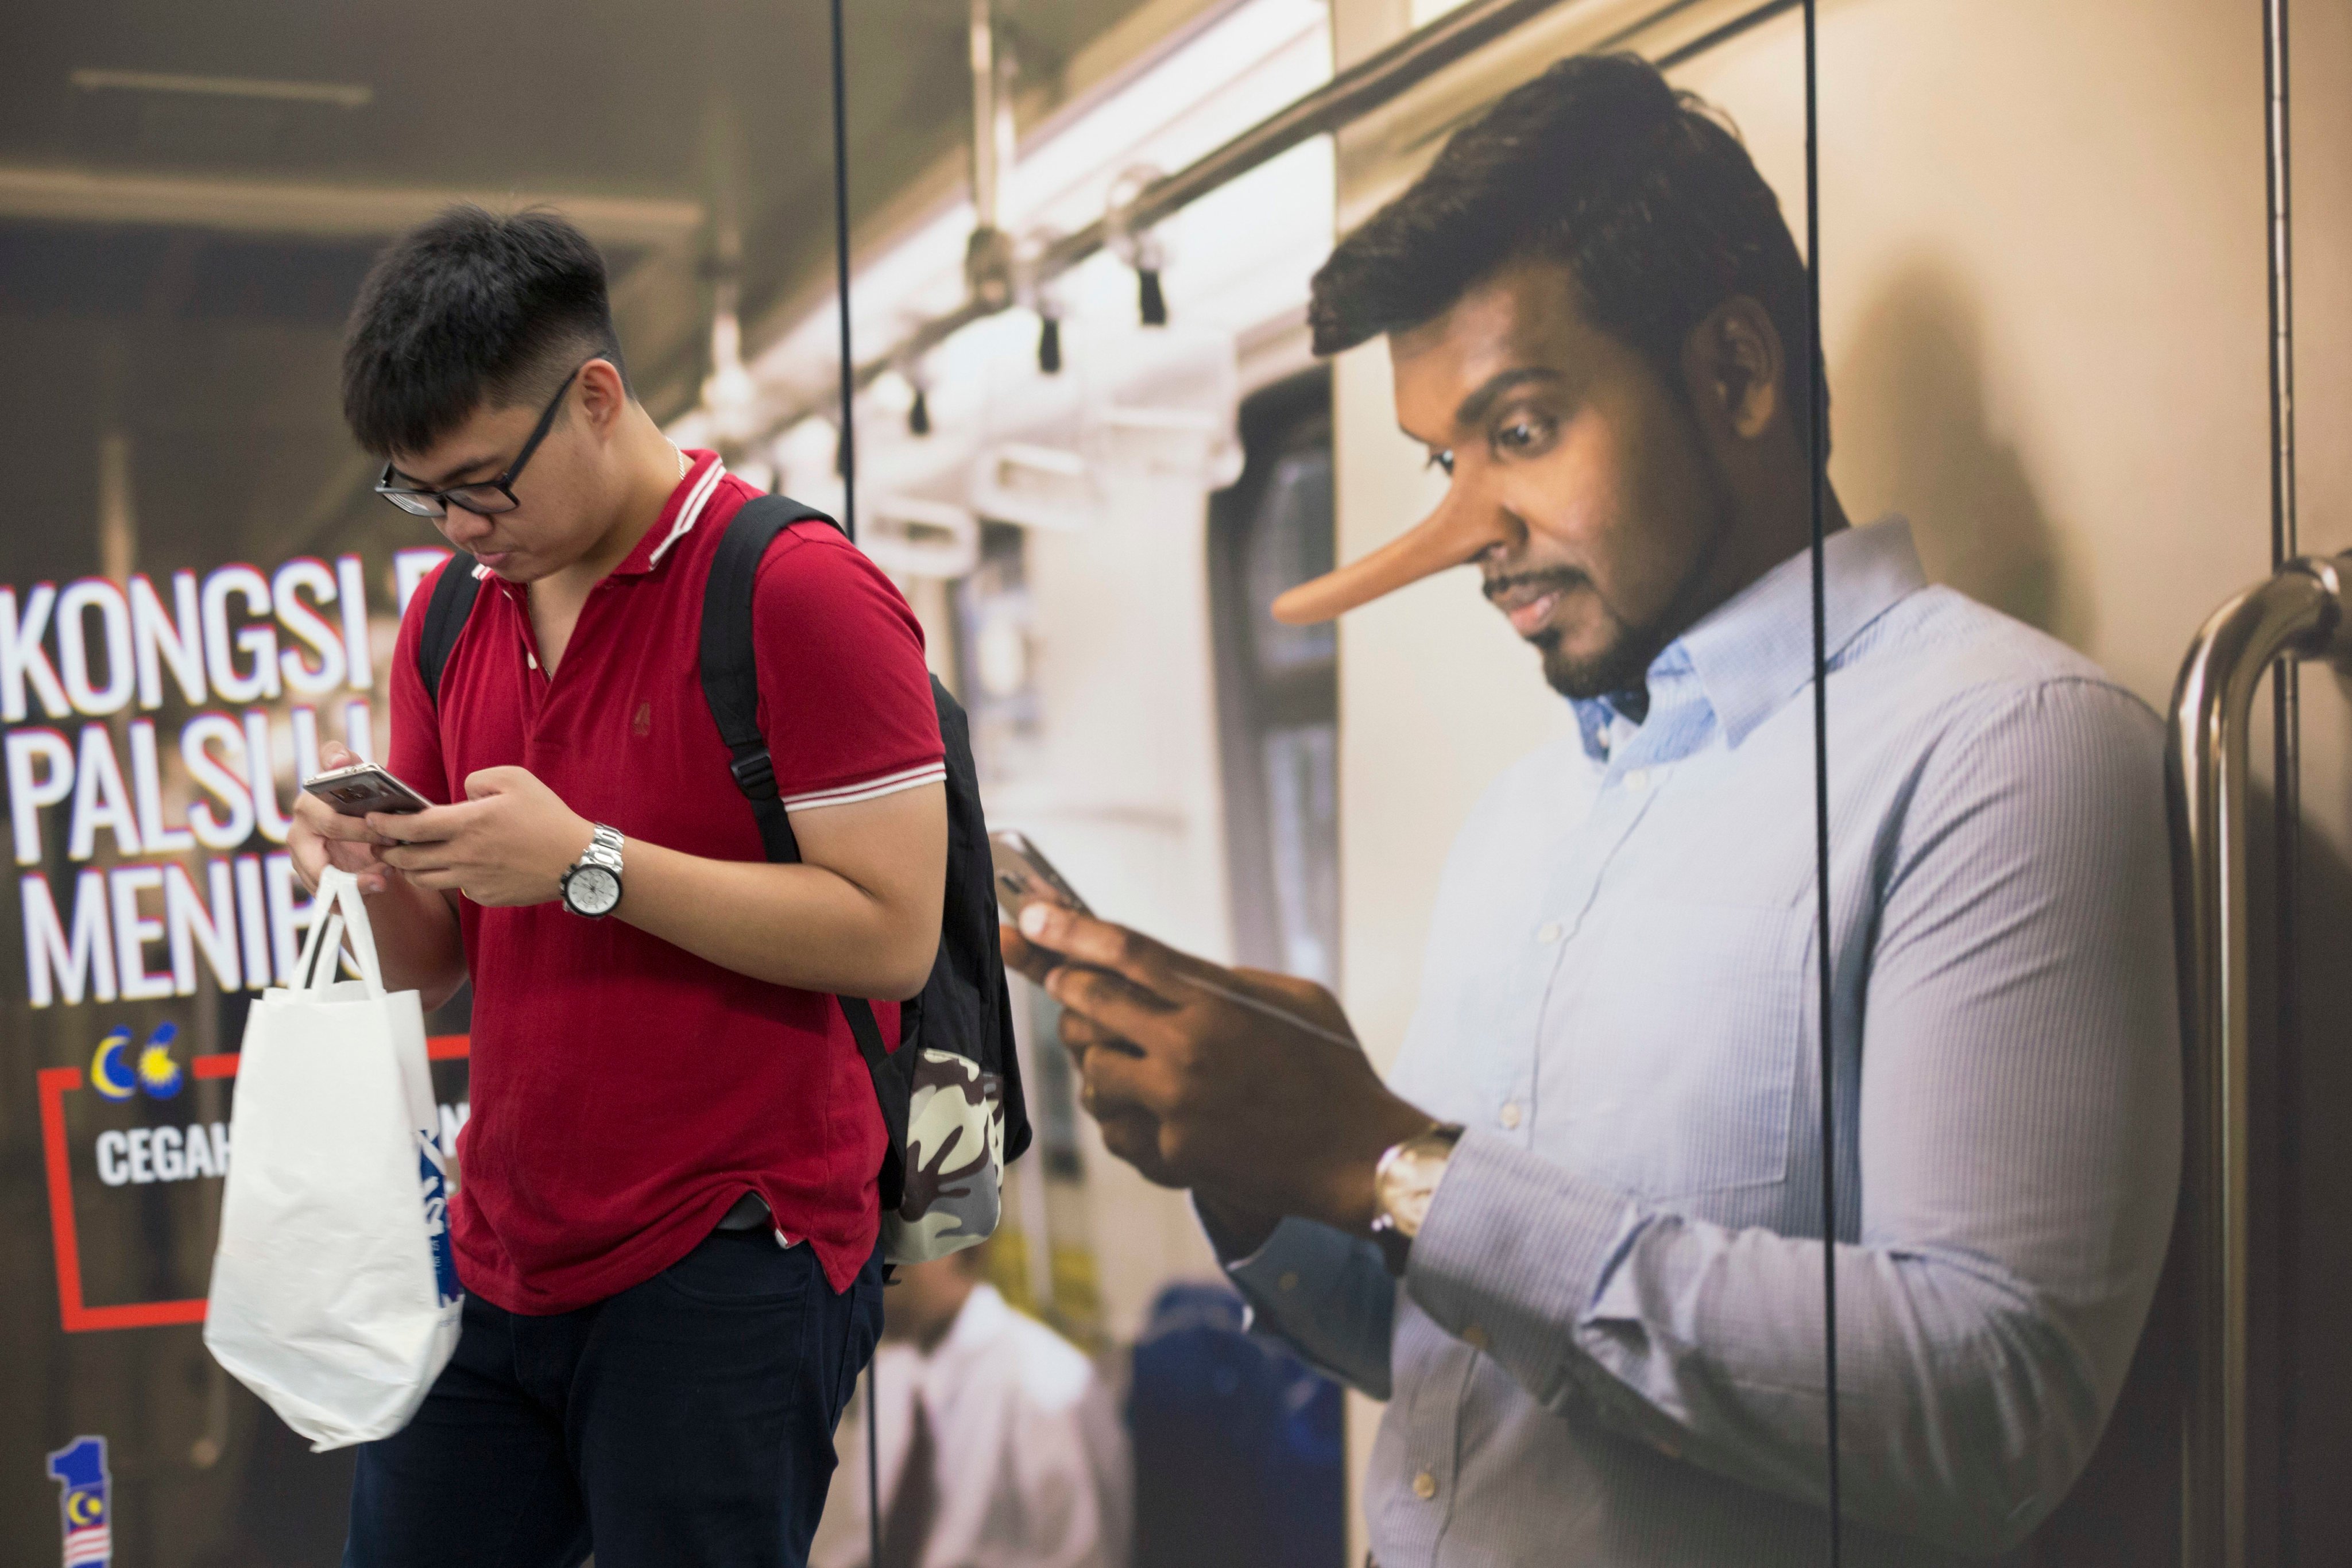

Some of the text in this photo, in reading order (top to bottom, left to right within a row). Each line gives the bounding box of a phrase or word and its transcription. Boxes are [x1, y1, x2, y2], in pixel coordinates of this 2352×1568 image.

[0, 553, 373, 722] KONGSI
[5, 704, 319, 866] PALSU
[20, 851, 365, 1009] MENIP
